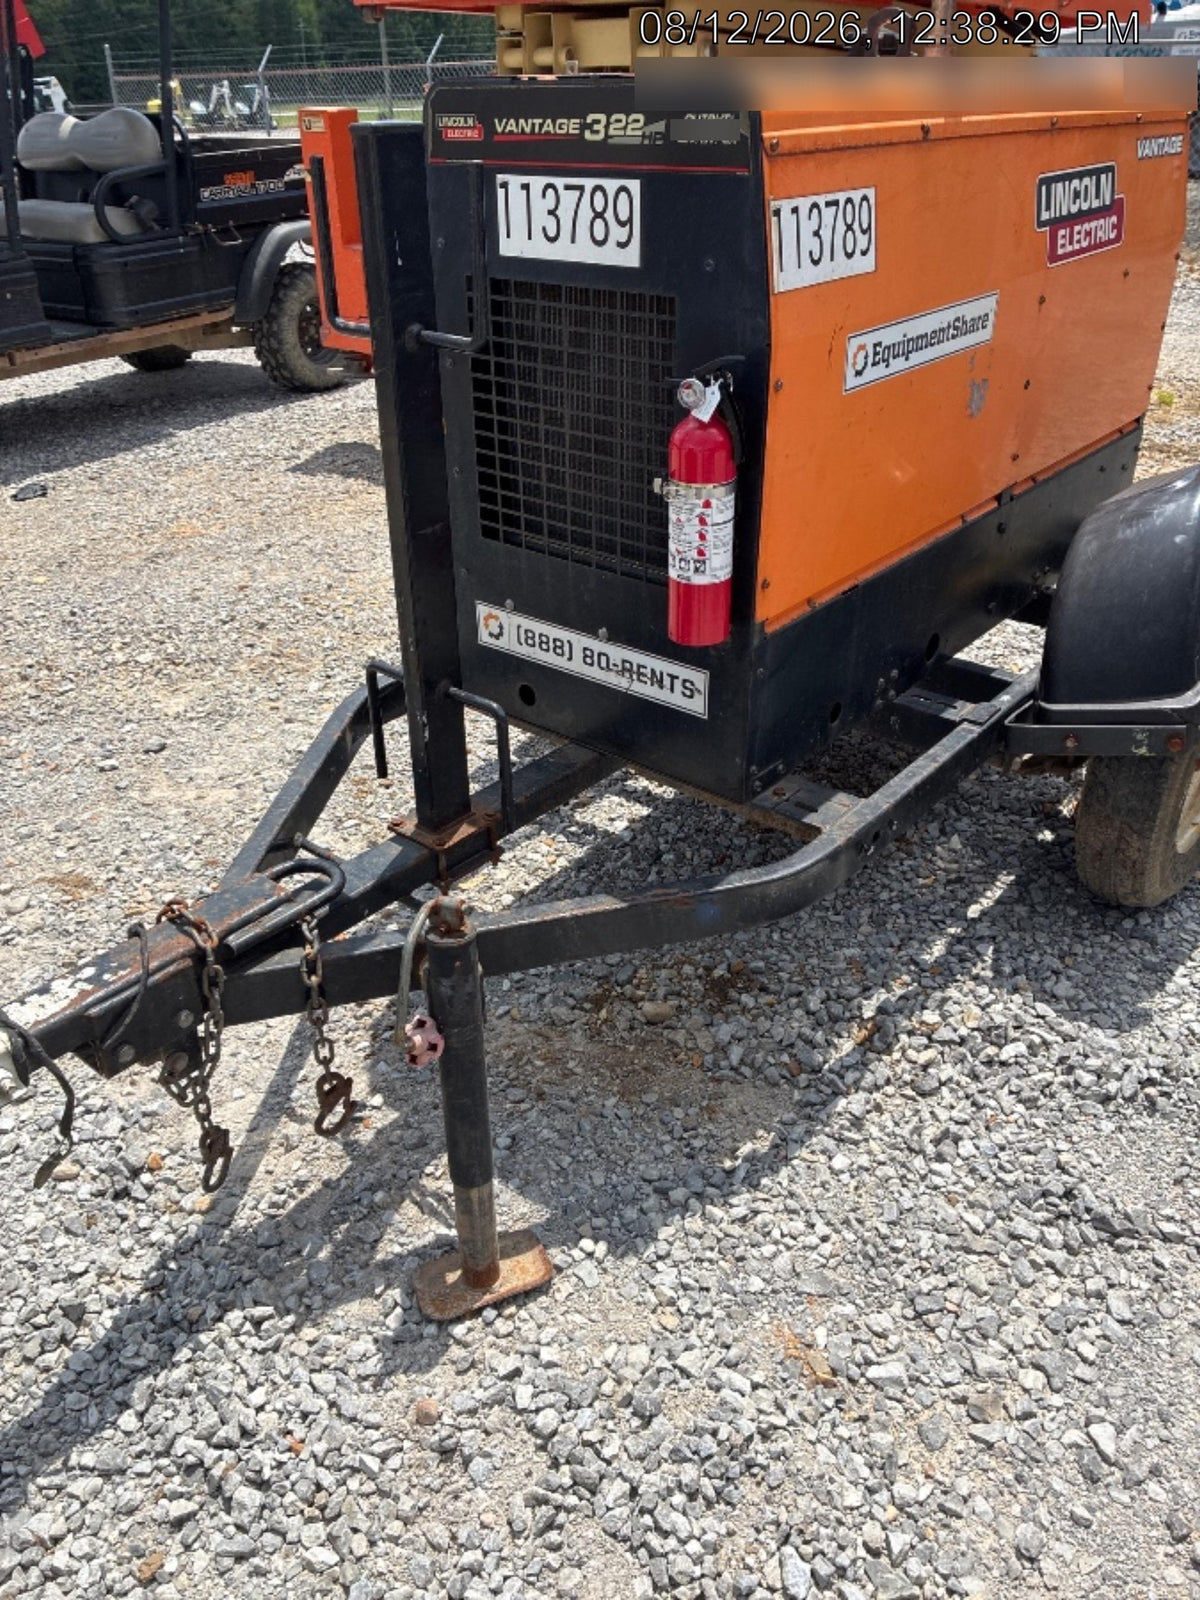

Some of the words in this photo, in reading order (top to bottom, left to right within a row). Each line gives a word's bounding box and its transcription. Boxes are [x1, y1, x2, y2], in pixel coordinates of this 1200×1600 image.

[438, 116, 474, 128] LINCOLN
[494, 118, 581, 134] VANTAGE
[584, 113, 645, 141] 322
[1137, 135, 1183, 158] VANTAGE
[498, 181, 634, 249] 113789
[1040, 172, 1112, 221] LINCOLN
[772, 194, 872, 273] 113789
[1057, 215, 1117, 255] ELECTRIC
[871, 312, 990, 368] EquipmentShare
[516, 625, 573, 662] (888)
[582, 647, 696, 699] 80-RENTS
